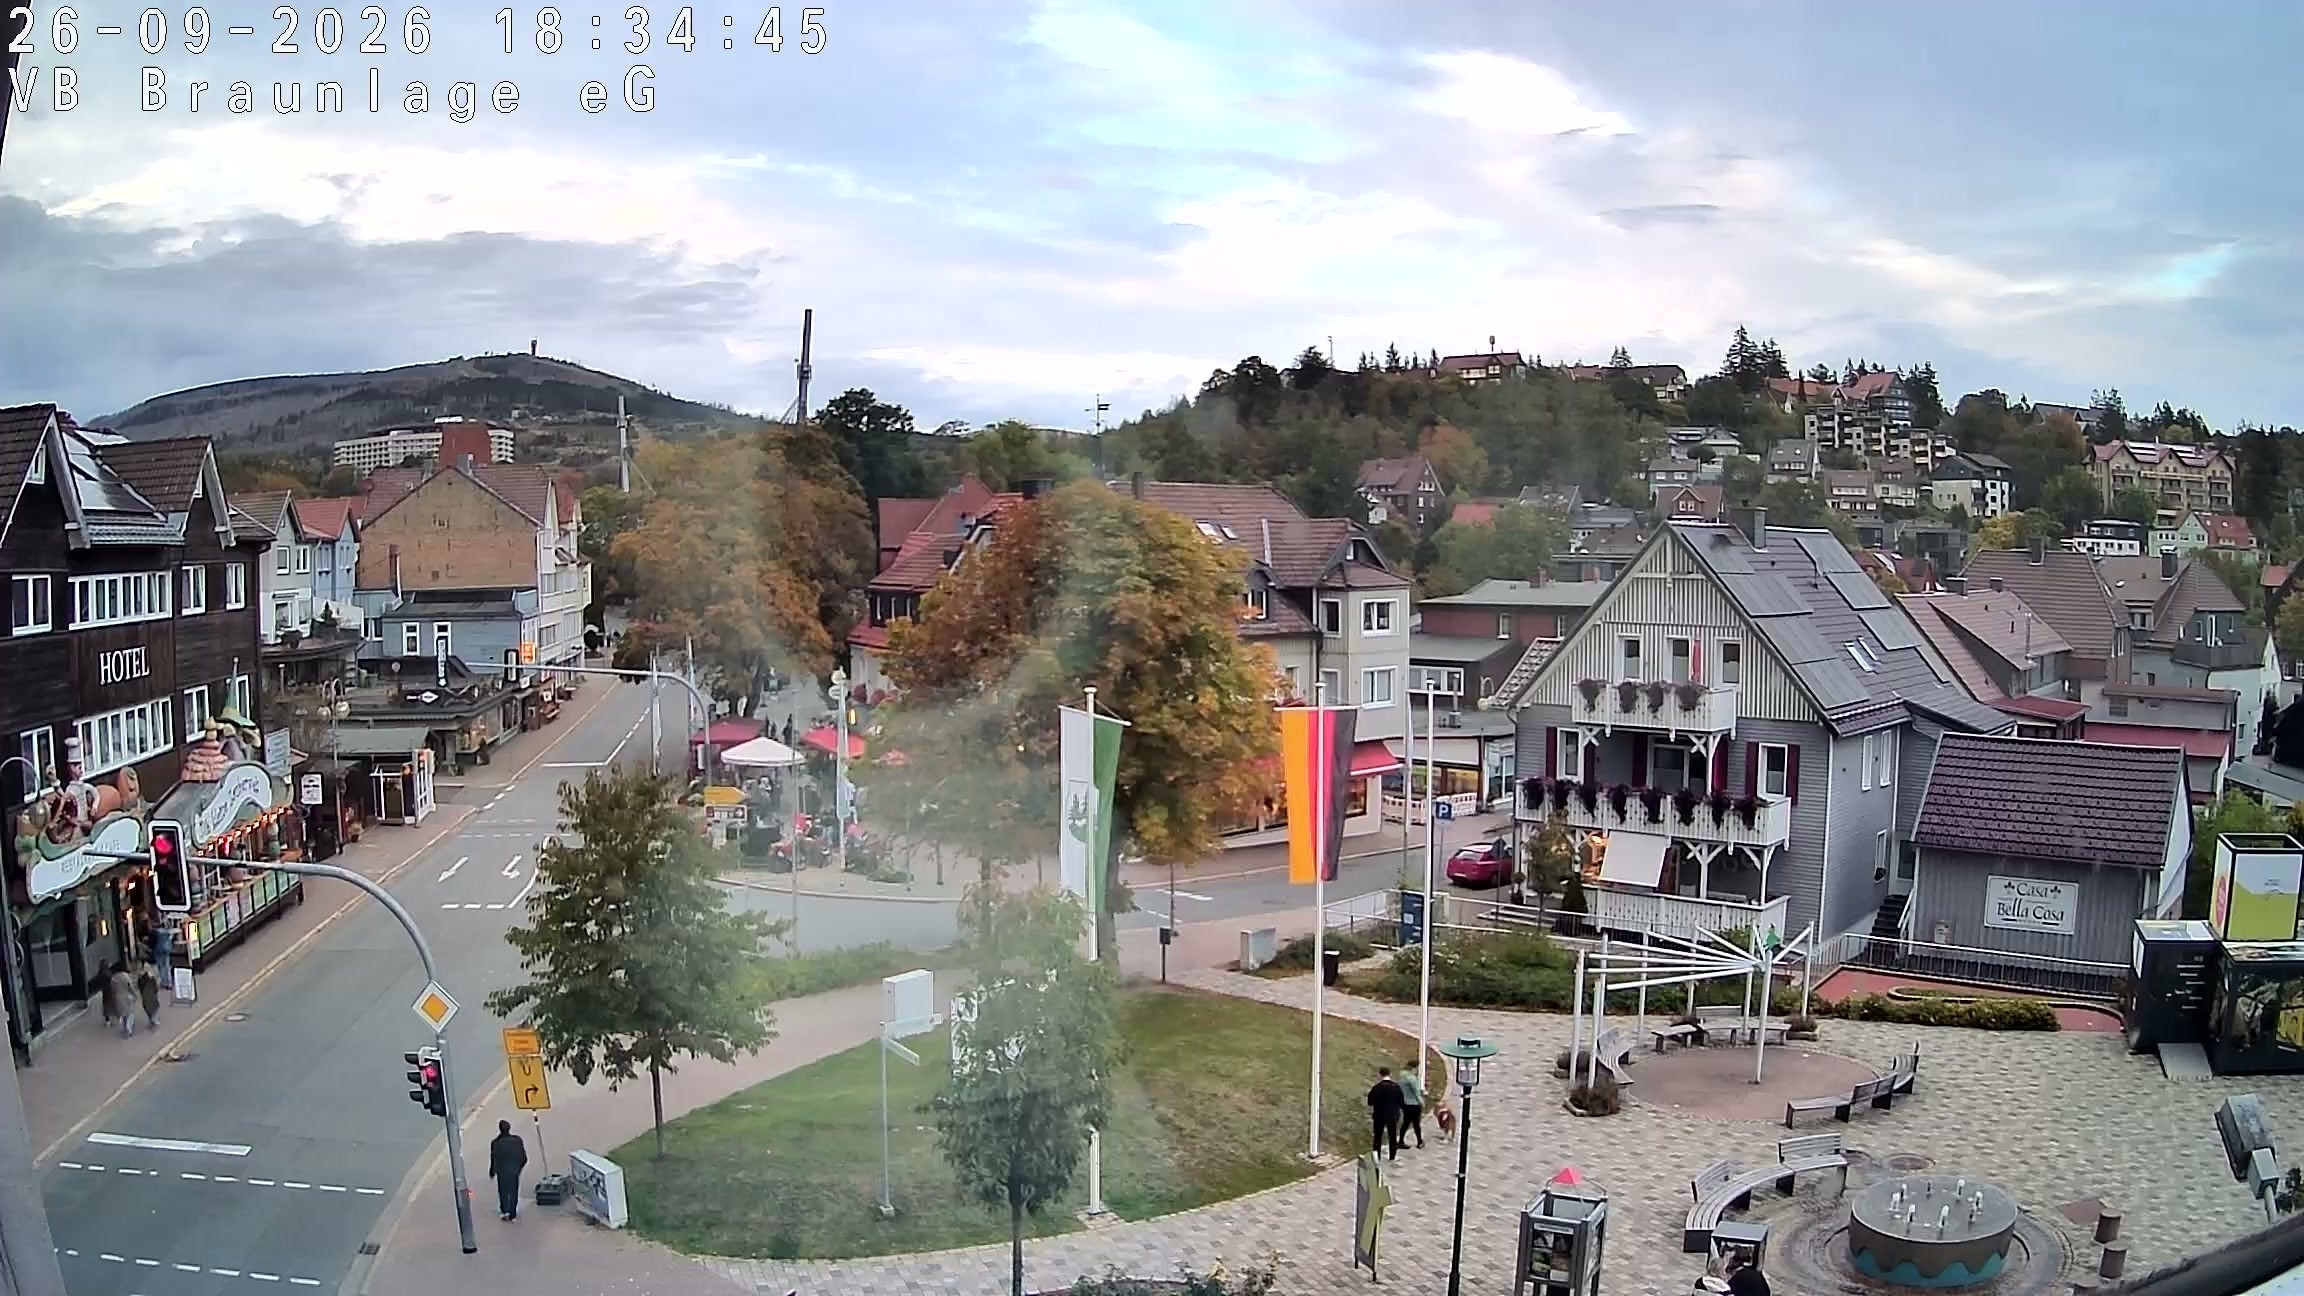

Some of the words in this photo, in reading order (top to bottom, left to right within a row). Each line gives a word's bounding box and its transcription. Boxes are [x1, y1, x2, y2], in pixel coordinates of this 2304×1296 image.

[99, 646, 150, 686] HOTEL
[1439, 804, 1449, 817] P
[2016, 882, 2048, 898] Casa
[1997, 898, 2029, 918] Bella
